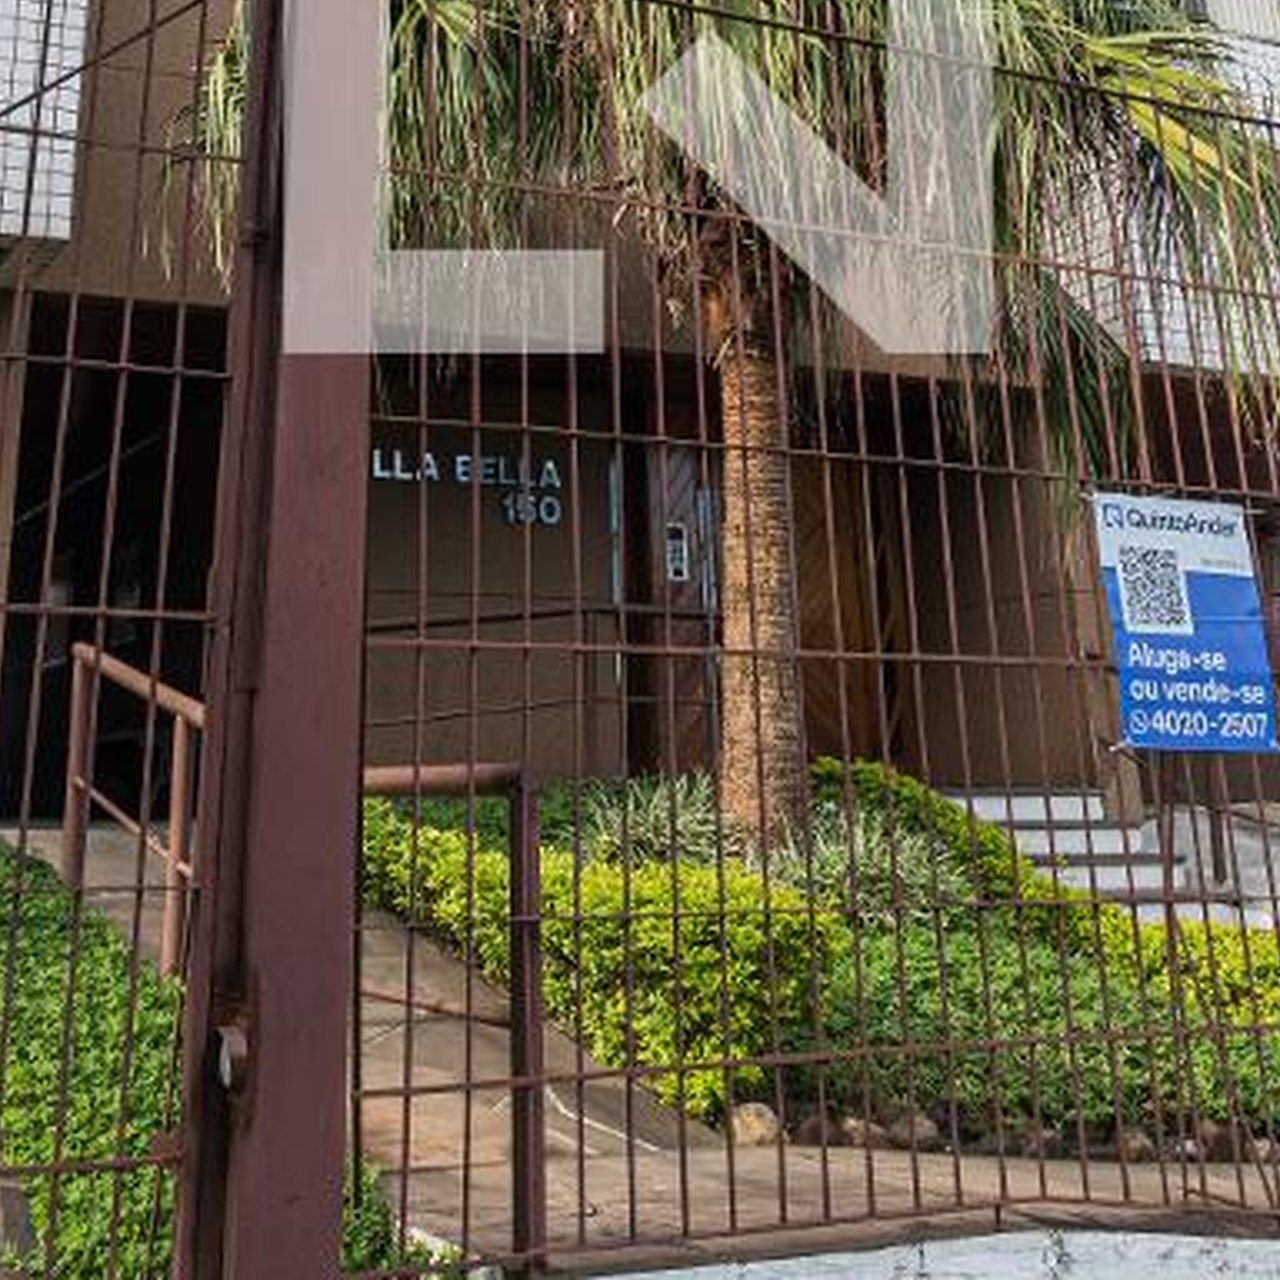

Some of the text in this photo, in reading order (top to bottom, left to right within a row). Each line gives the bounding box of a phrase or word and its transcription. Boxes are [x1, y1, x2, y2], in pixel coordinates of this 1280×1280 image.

[373, 449, 439, 481] LLA
[1128, 643, 1227, 675] Aluga-se
[1130, 679, 1265, 704] ou vende-se
[1152, 711, 1268, 738] 4020-2507
